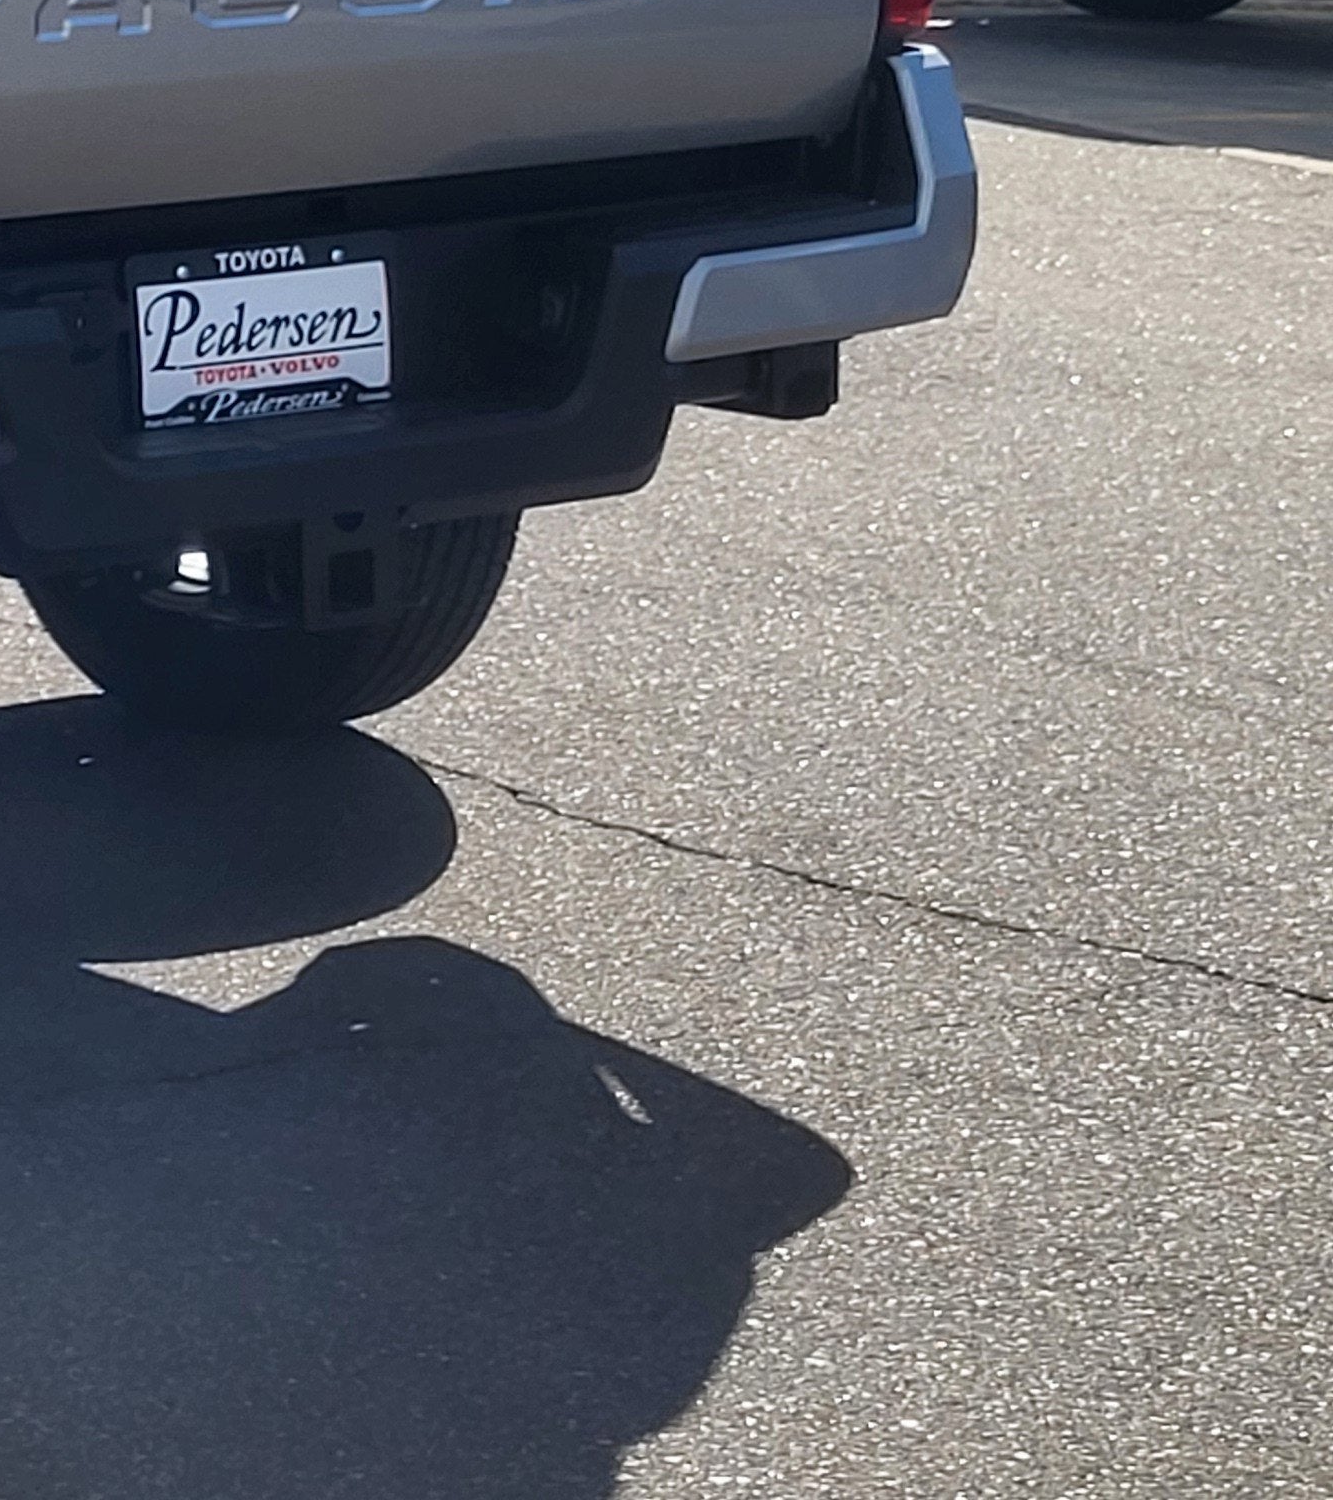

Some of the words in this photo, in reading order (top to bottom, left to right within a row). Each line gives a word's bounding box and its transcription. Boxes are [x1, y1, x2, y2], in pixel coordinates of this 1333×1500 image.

[215, 245, 306, 274] TOYOTA
[144, 290, 382, 372] Pedersen
[195, 365, 257, 385] TOYOTA
[273, 355, 340, 376] VOLVO
